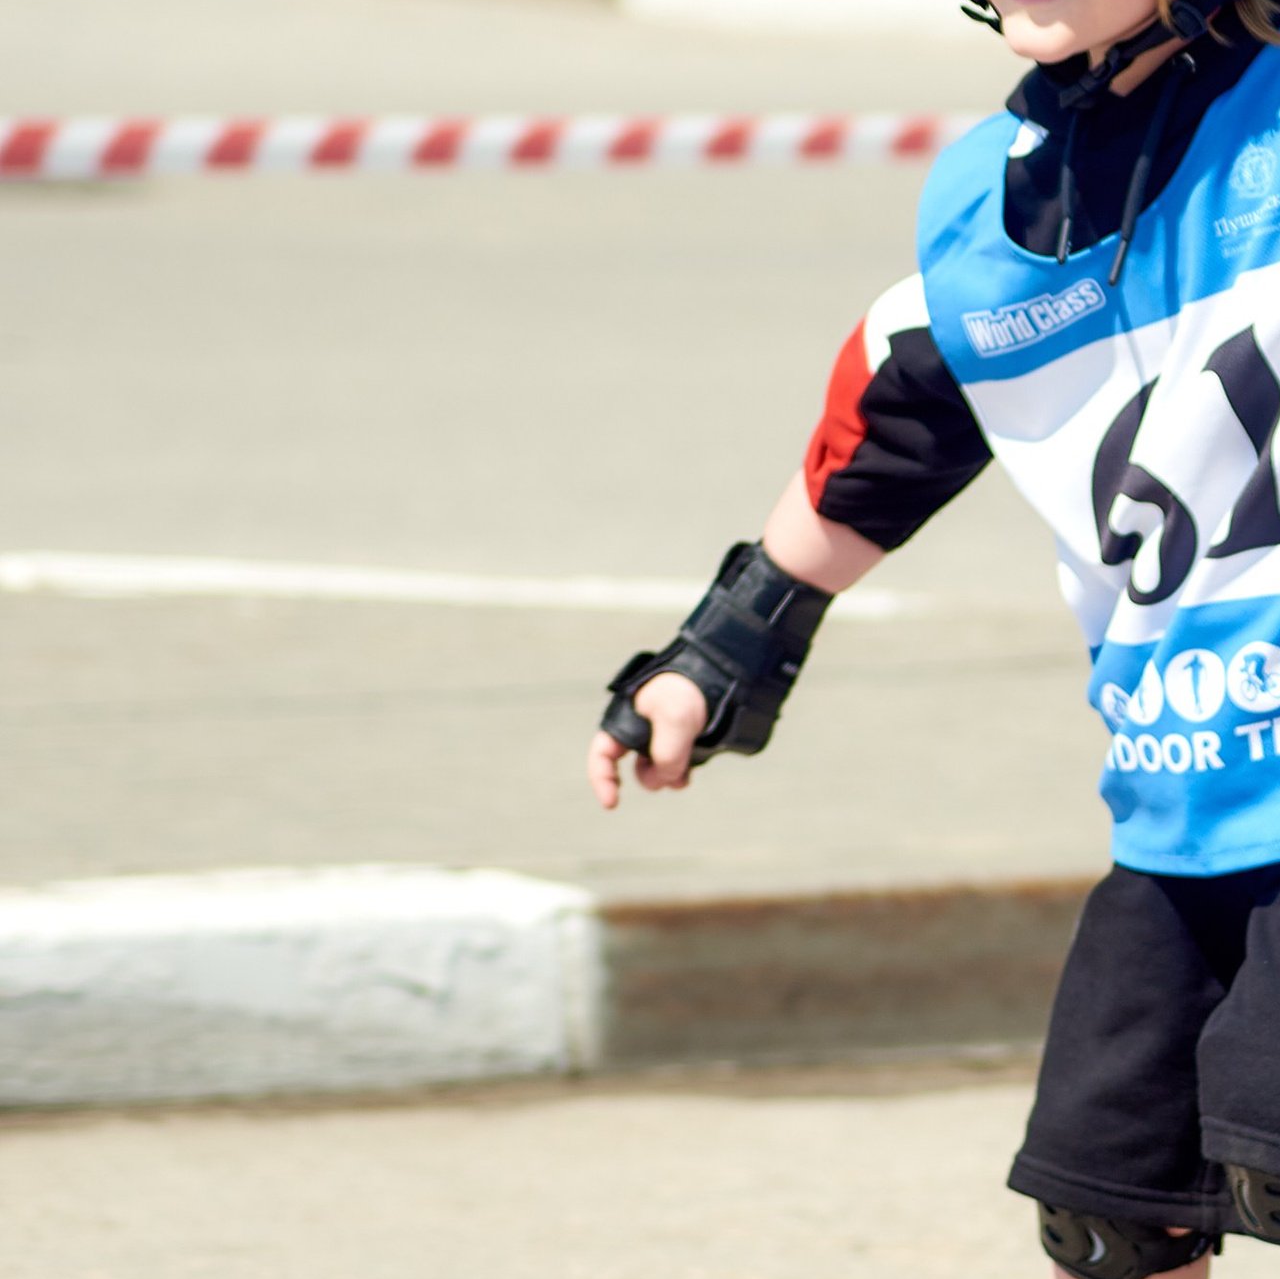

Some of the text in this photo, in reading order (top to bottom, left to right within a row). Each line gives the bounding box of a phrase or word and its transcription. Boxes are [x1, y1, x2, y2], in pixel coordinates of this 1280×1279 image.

[970, 282, 1099, 350] World Class
[1106, 730, 1225, 774] DOOR
